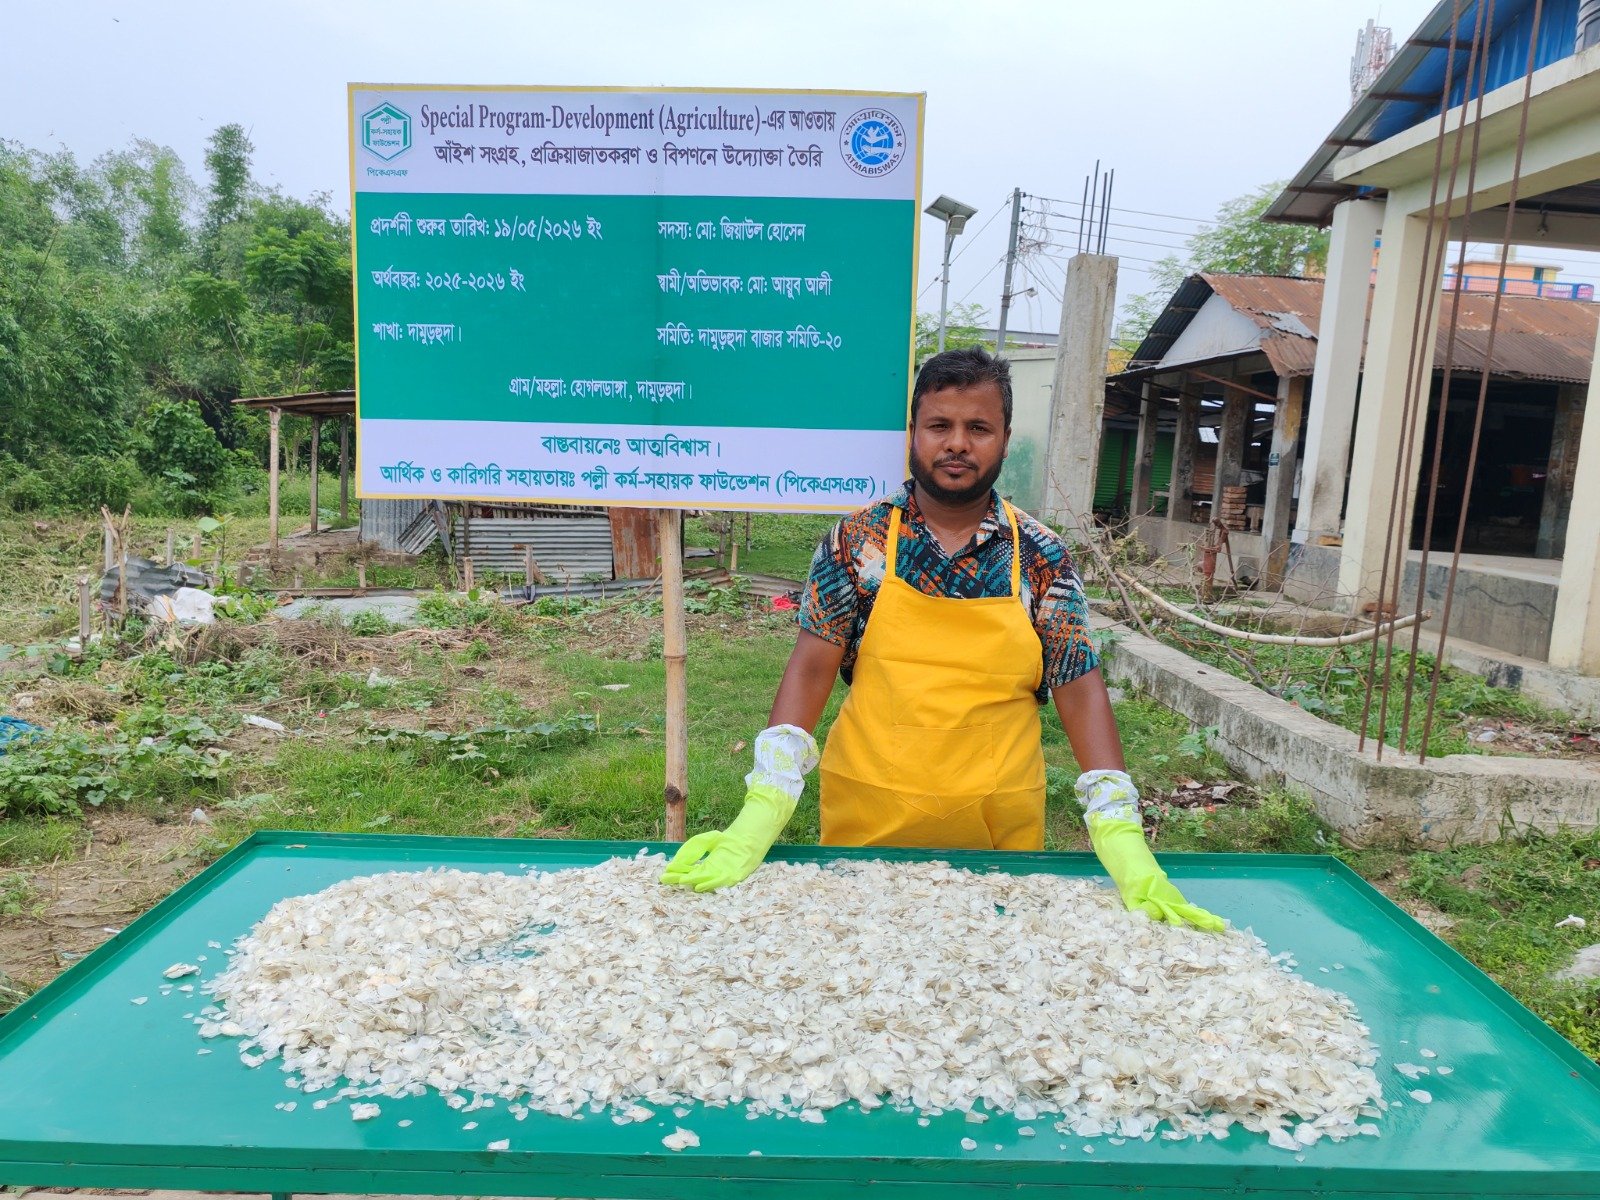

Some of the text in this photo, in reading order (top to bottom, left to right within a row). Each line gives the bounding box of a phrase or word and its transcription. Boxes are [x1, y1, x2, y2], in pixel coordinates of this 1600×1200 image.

[421, 103, 836, 137] Special Program-Development (Agriculture)-এর আওতায়
[434, 140, 823, 168] আঁইশ সংগ্রহ, প্রক্রিয়াজাতকরণ ও বিপণনে উদ্যোক্তা তৈরি
[845, 153, 899, 174] ATMABISWAS
[370, 212, 603, 241] প্রদর্শনী শুরুর তারিখ: ১৯/০৫/২০২৬ ইং
[657, 215, 806, 242] সদস্য: মো: জিয়াউল হোসেন
[371, 265, 527, 292] অর্থবছর: ২০২৫-২০২৬ ইং
[656, 267, 743, 296] স্বামী/অভিভাবক:
[747, 275, 767, 294] মো:
[804, 271, 833, 296] আলী
[372, 323, 402, 341] শাখা:
[656, 322, 842, 351] সমিতি: দামুড়হুদা বাজার সমিতি-২০
[380, 460, 425, 483] আর্থিক
[430, 468, 441, 482] ও
[447, 462, 502, 485] কারিগরি
[581, 465, 609, 490] পল্লী
[614, 466, 694, 490] কর্ম-সহায়ক
[699, 469, 771, 493] ফাউন্ডেশন
